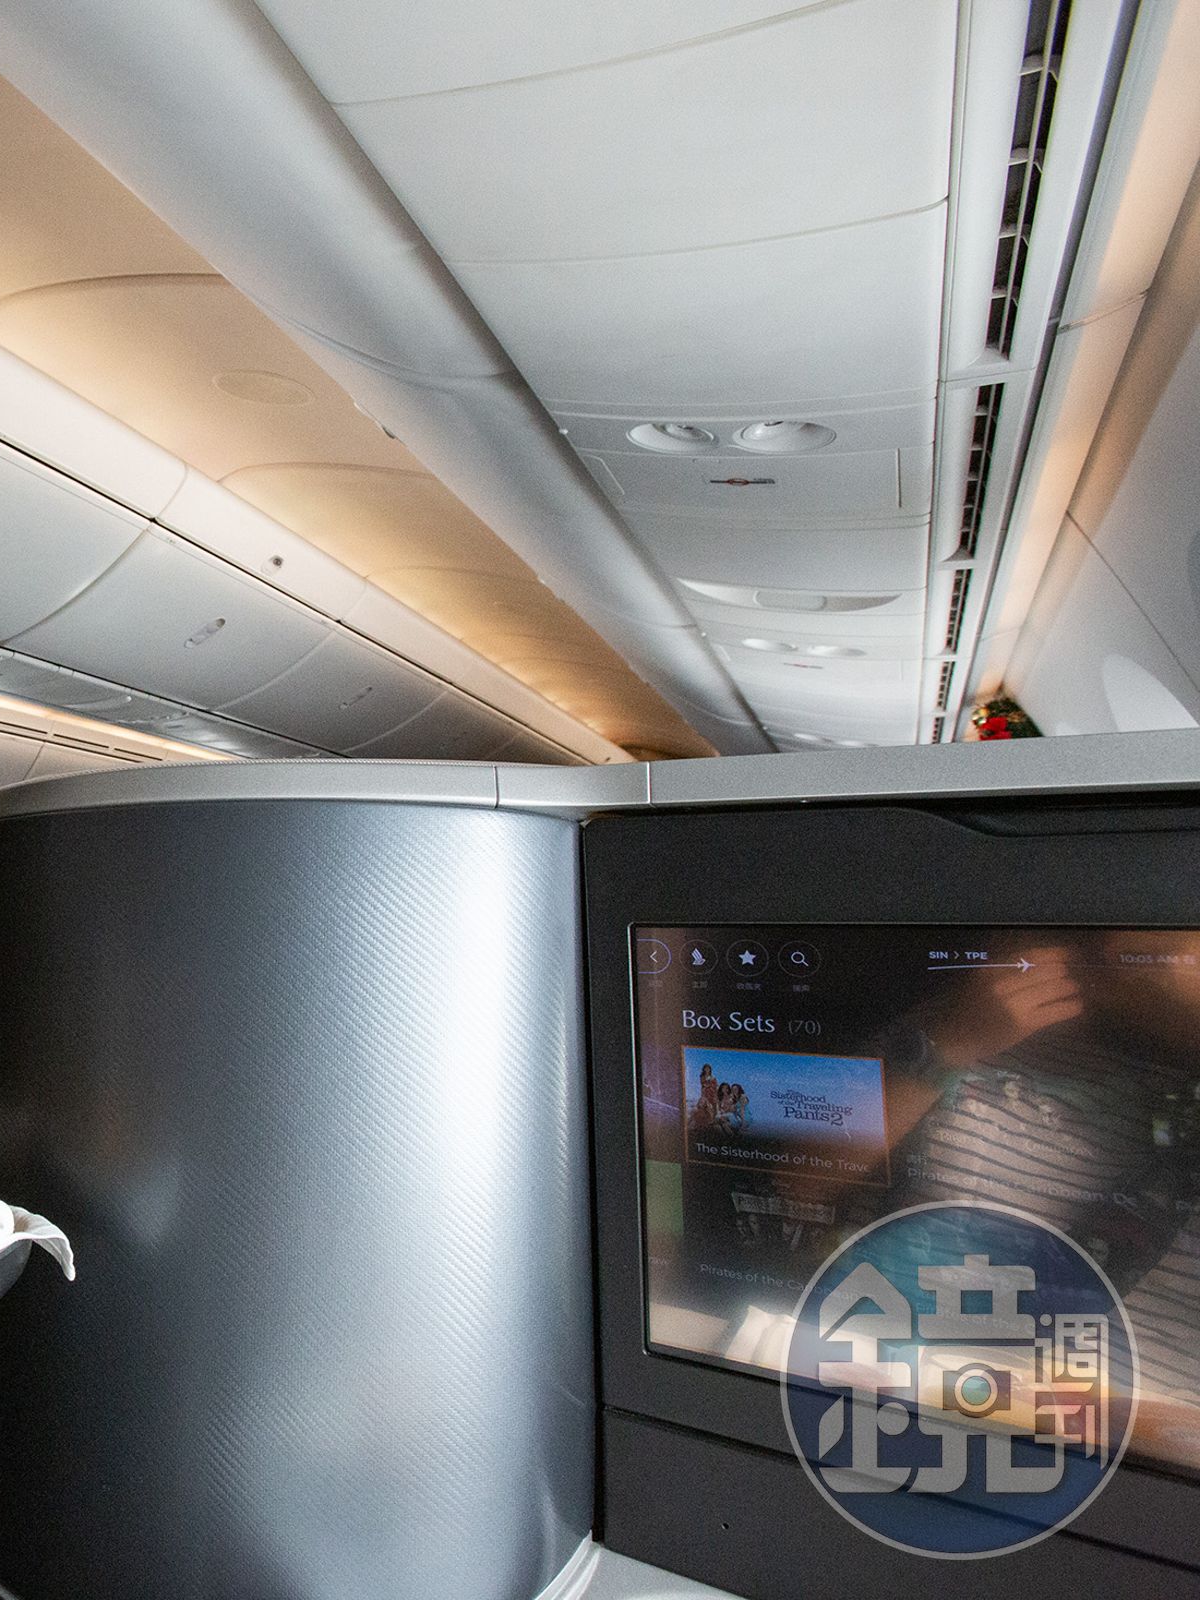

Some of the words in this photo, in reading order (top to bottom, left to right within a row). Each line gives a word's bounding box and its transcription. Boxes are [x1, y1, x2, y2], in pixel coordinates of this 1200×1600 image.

[928, 950, 949, 960] SIN
[964, 951, 988, 960] TPE
[681, 1009, 722, 1031] Box
[728, 1011, 776, 1033] Sets
[787, 1019, 822, 1036] (70)
[770, 1090, 826, 1103] Sisterhood
[797, 1100, 853, 1116] Traveling
[695, 1142, 718, 1155] The
[720, 1145, 789, 1163] Sisterhood
[792, 1153, 807, 1166] of
[809, 1156, 833, 1169] the
[907, 1167, 959, 1186] Pirates
[699, 1263, 743, 1281] Pirates
[745, 1272, 760, 1283] of
[761, 1275, 784, 1288] the
